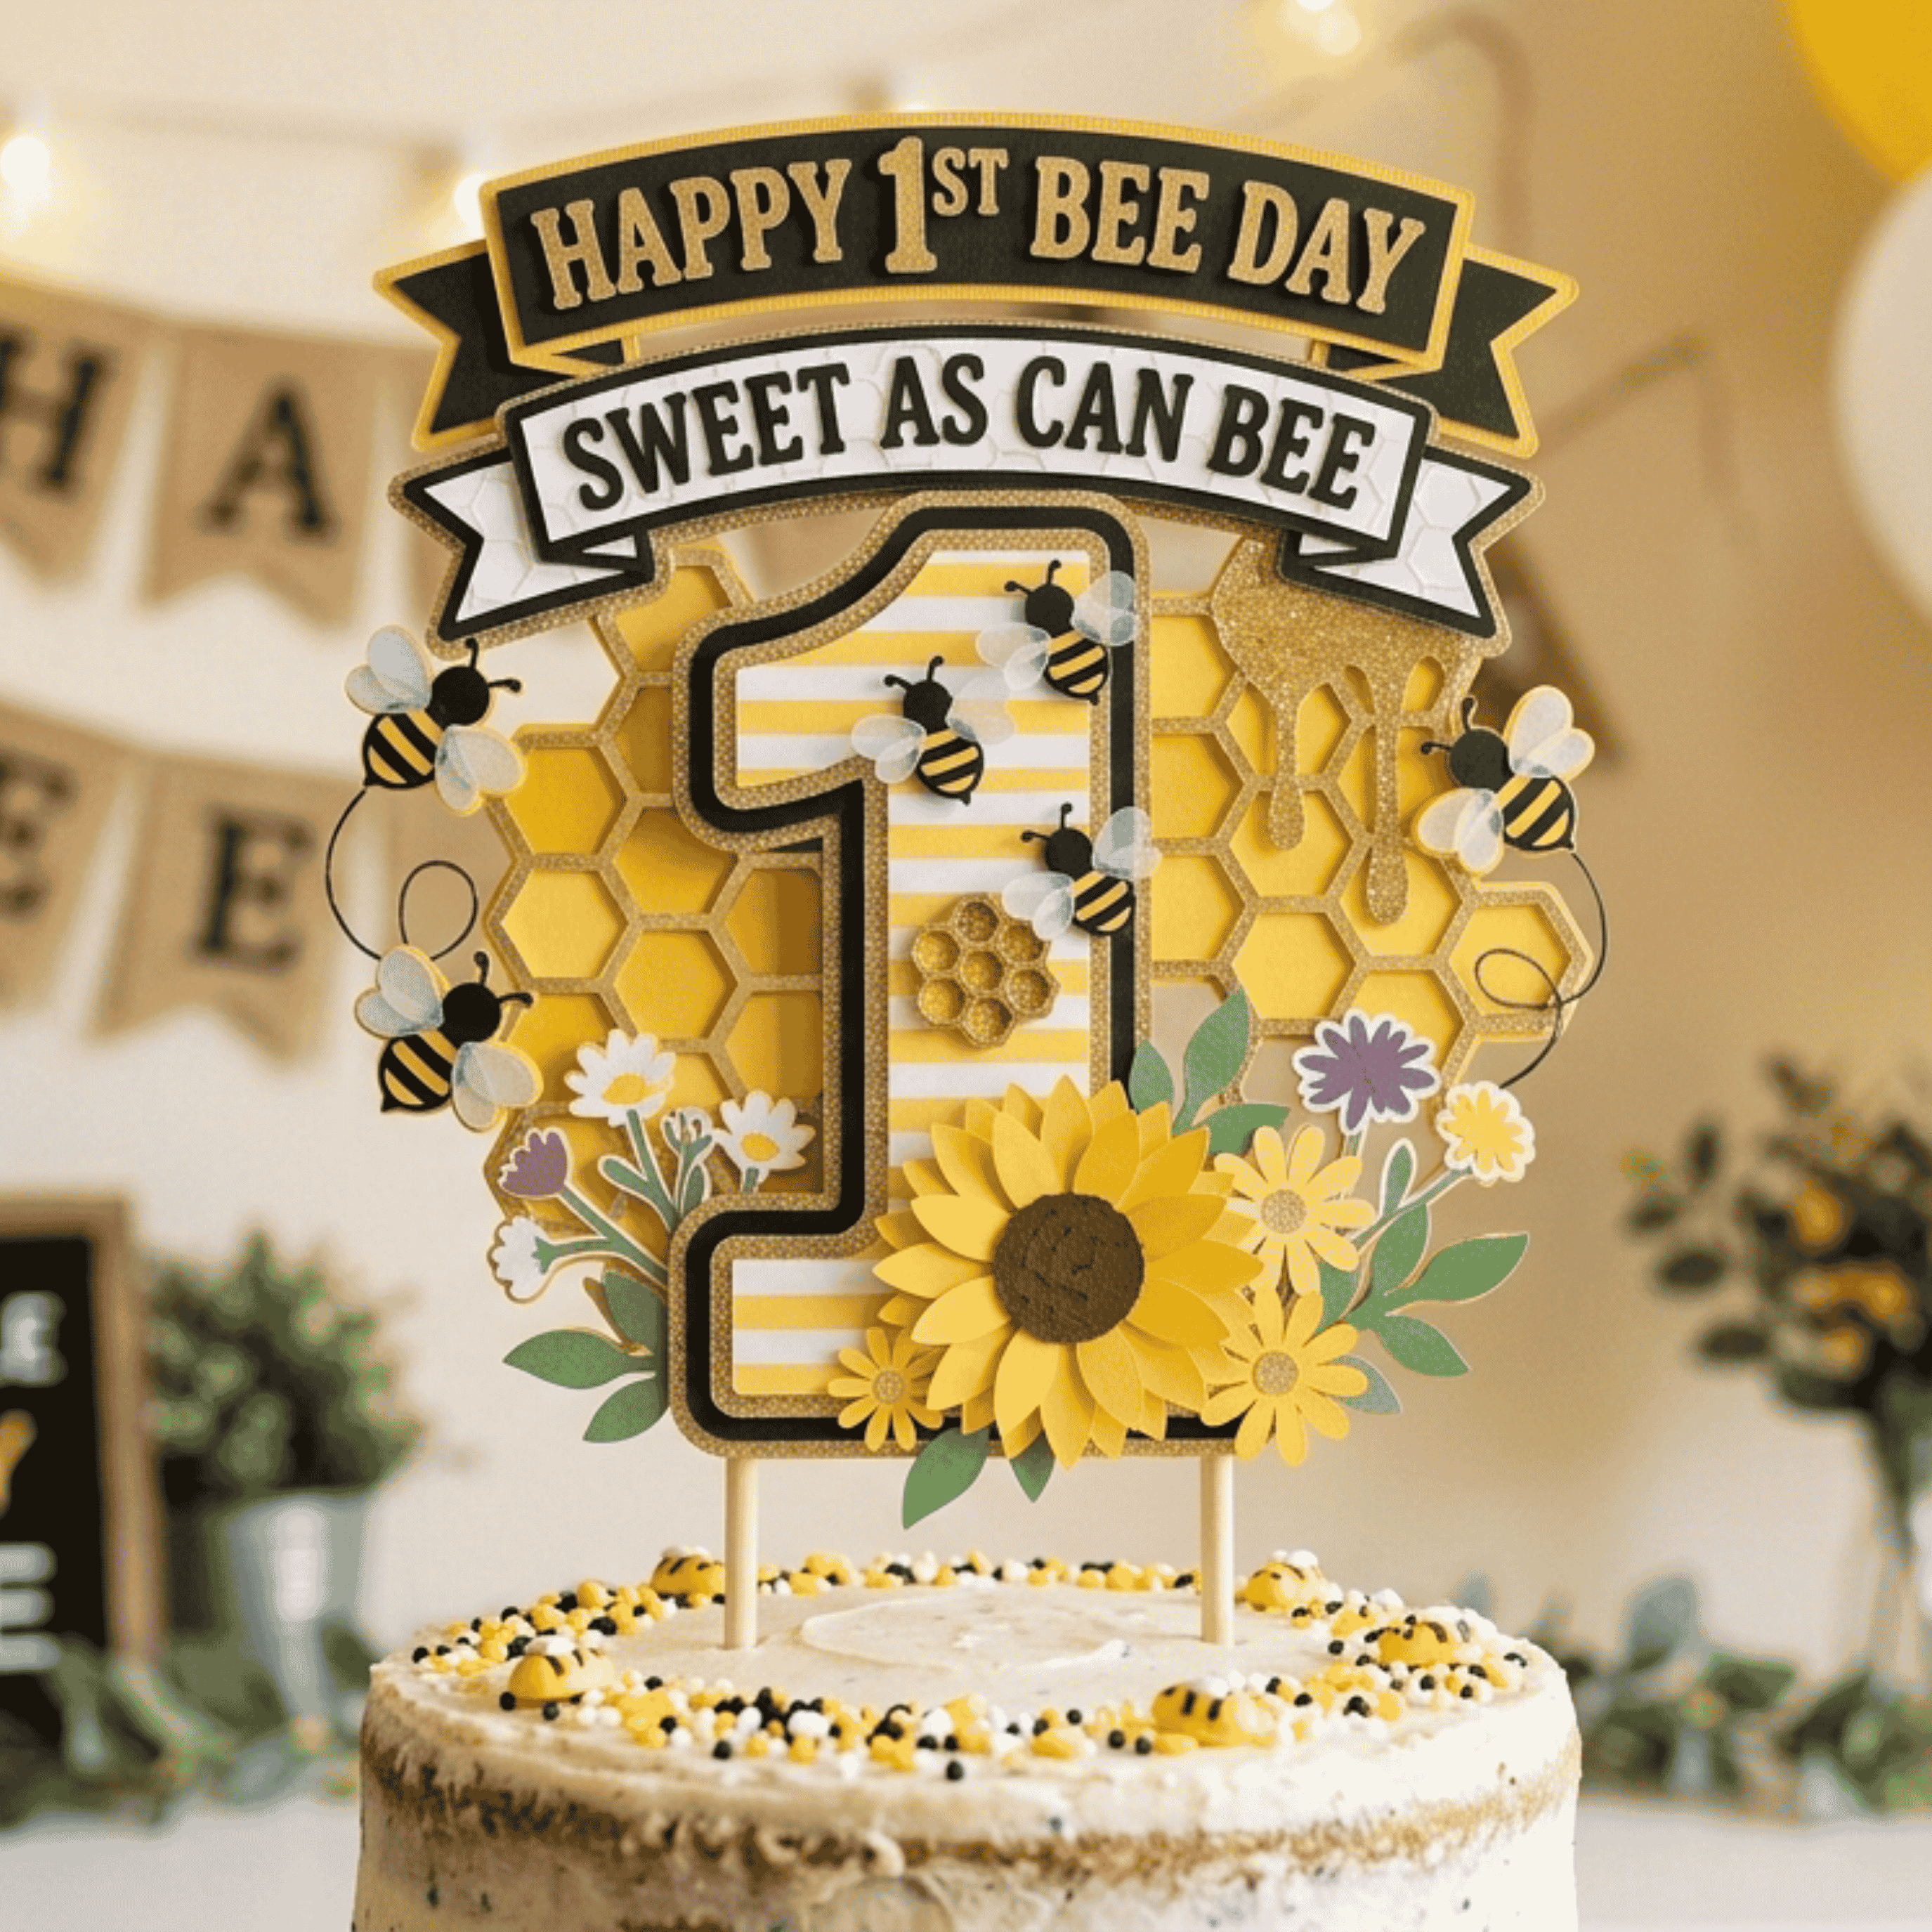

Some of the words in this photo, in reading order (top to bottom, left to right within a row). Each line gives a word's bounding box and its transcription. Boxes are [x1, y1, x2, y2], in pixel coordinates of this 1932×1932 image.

[530, 158, 852, 311] HAPPY
[878, 136, 1009, 273] 1ST
[1029, 155, 1210, 273] BEE
[1227, 180, 1426, 315] DAY
[562, 362, 851, 511] SWEET
[880, 353, 988, 450] AS
[1014, 355, 1194, 462] CAN
[1206, 384, 1376, 510] BEE
